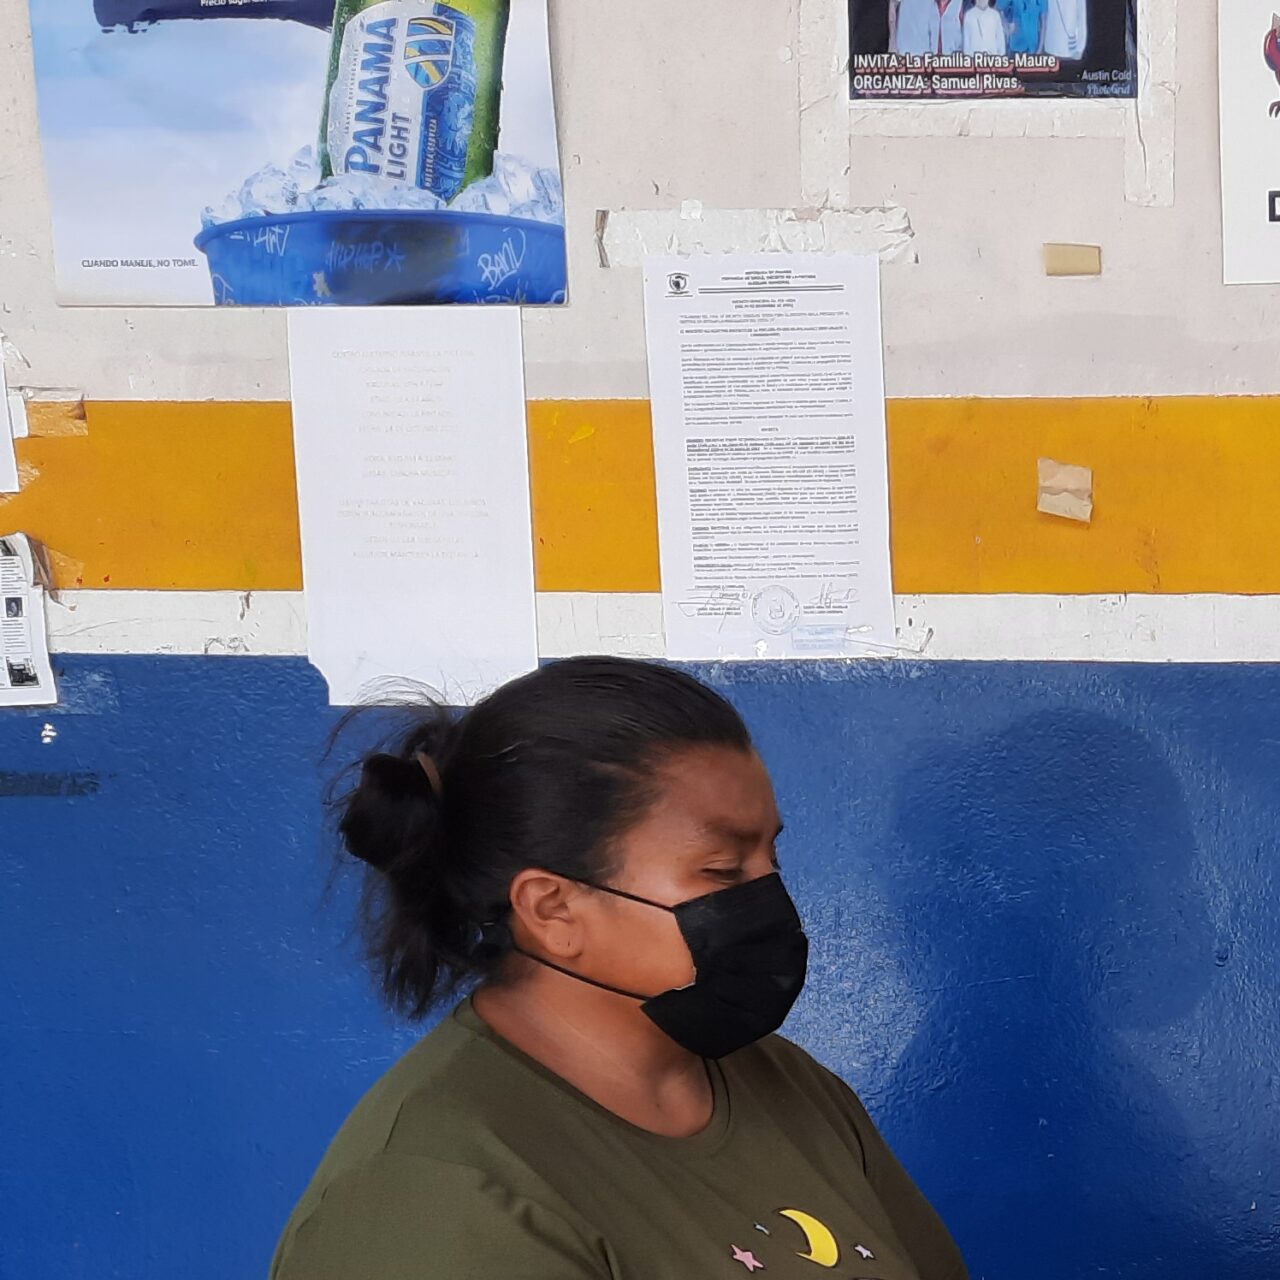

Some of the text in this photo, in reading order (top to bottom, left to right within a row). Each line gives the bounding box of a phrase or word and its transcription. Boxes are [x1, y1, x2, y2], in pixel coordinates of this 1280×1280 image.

[853, 53, 1056, 69] INVITA: La Familia Rivas-Maure
[853, 75, 929, 89] ORGANIZA:
[932, 74, 979, 89] Samuel
[1081, 69, 1110, 81] Austin
[344, 17, 398, 176] PANAMÁ
[386, 112, 414, 180] LIGHT
[81, 260, 119, 268] CUANDO
